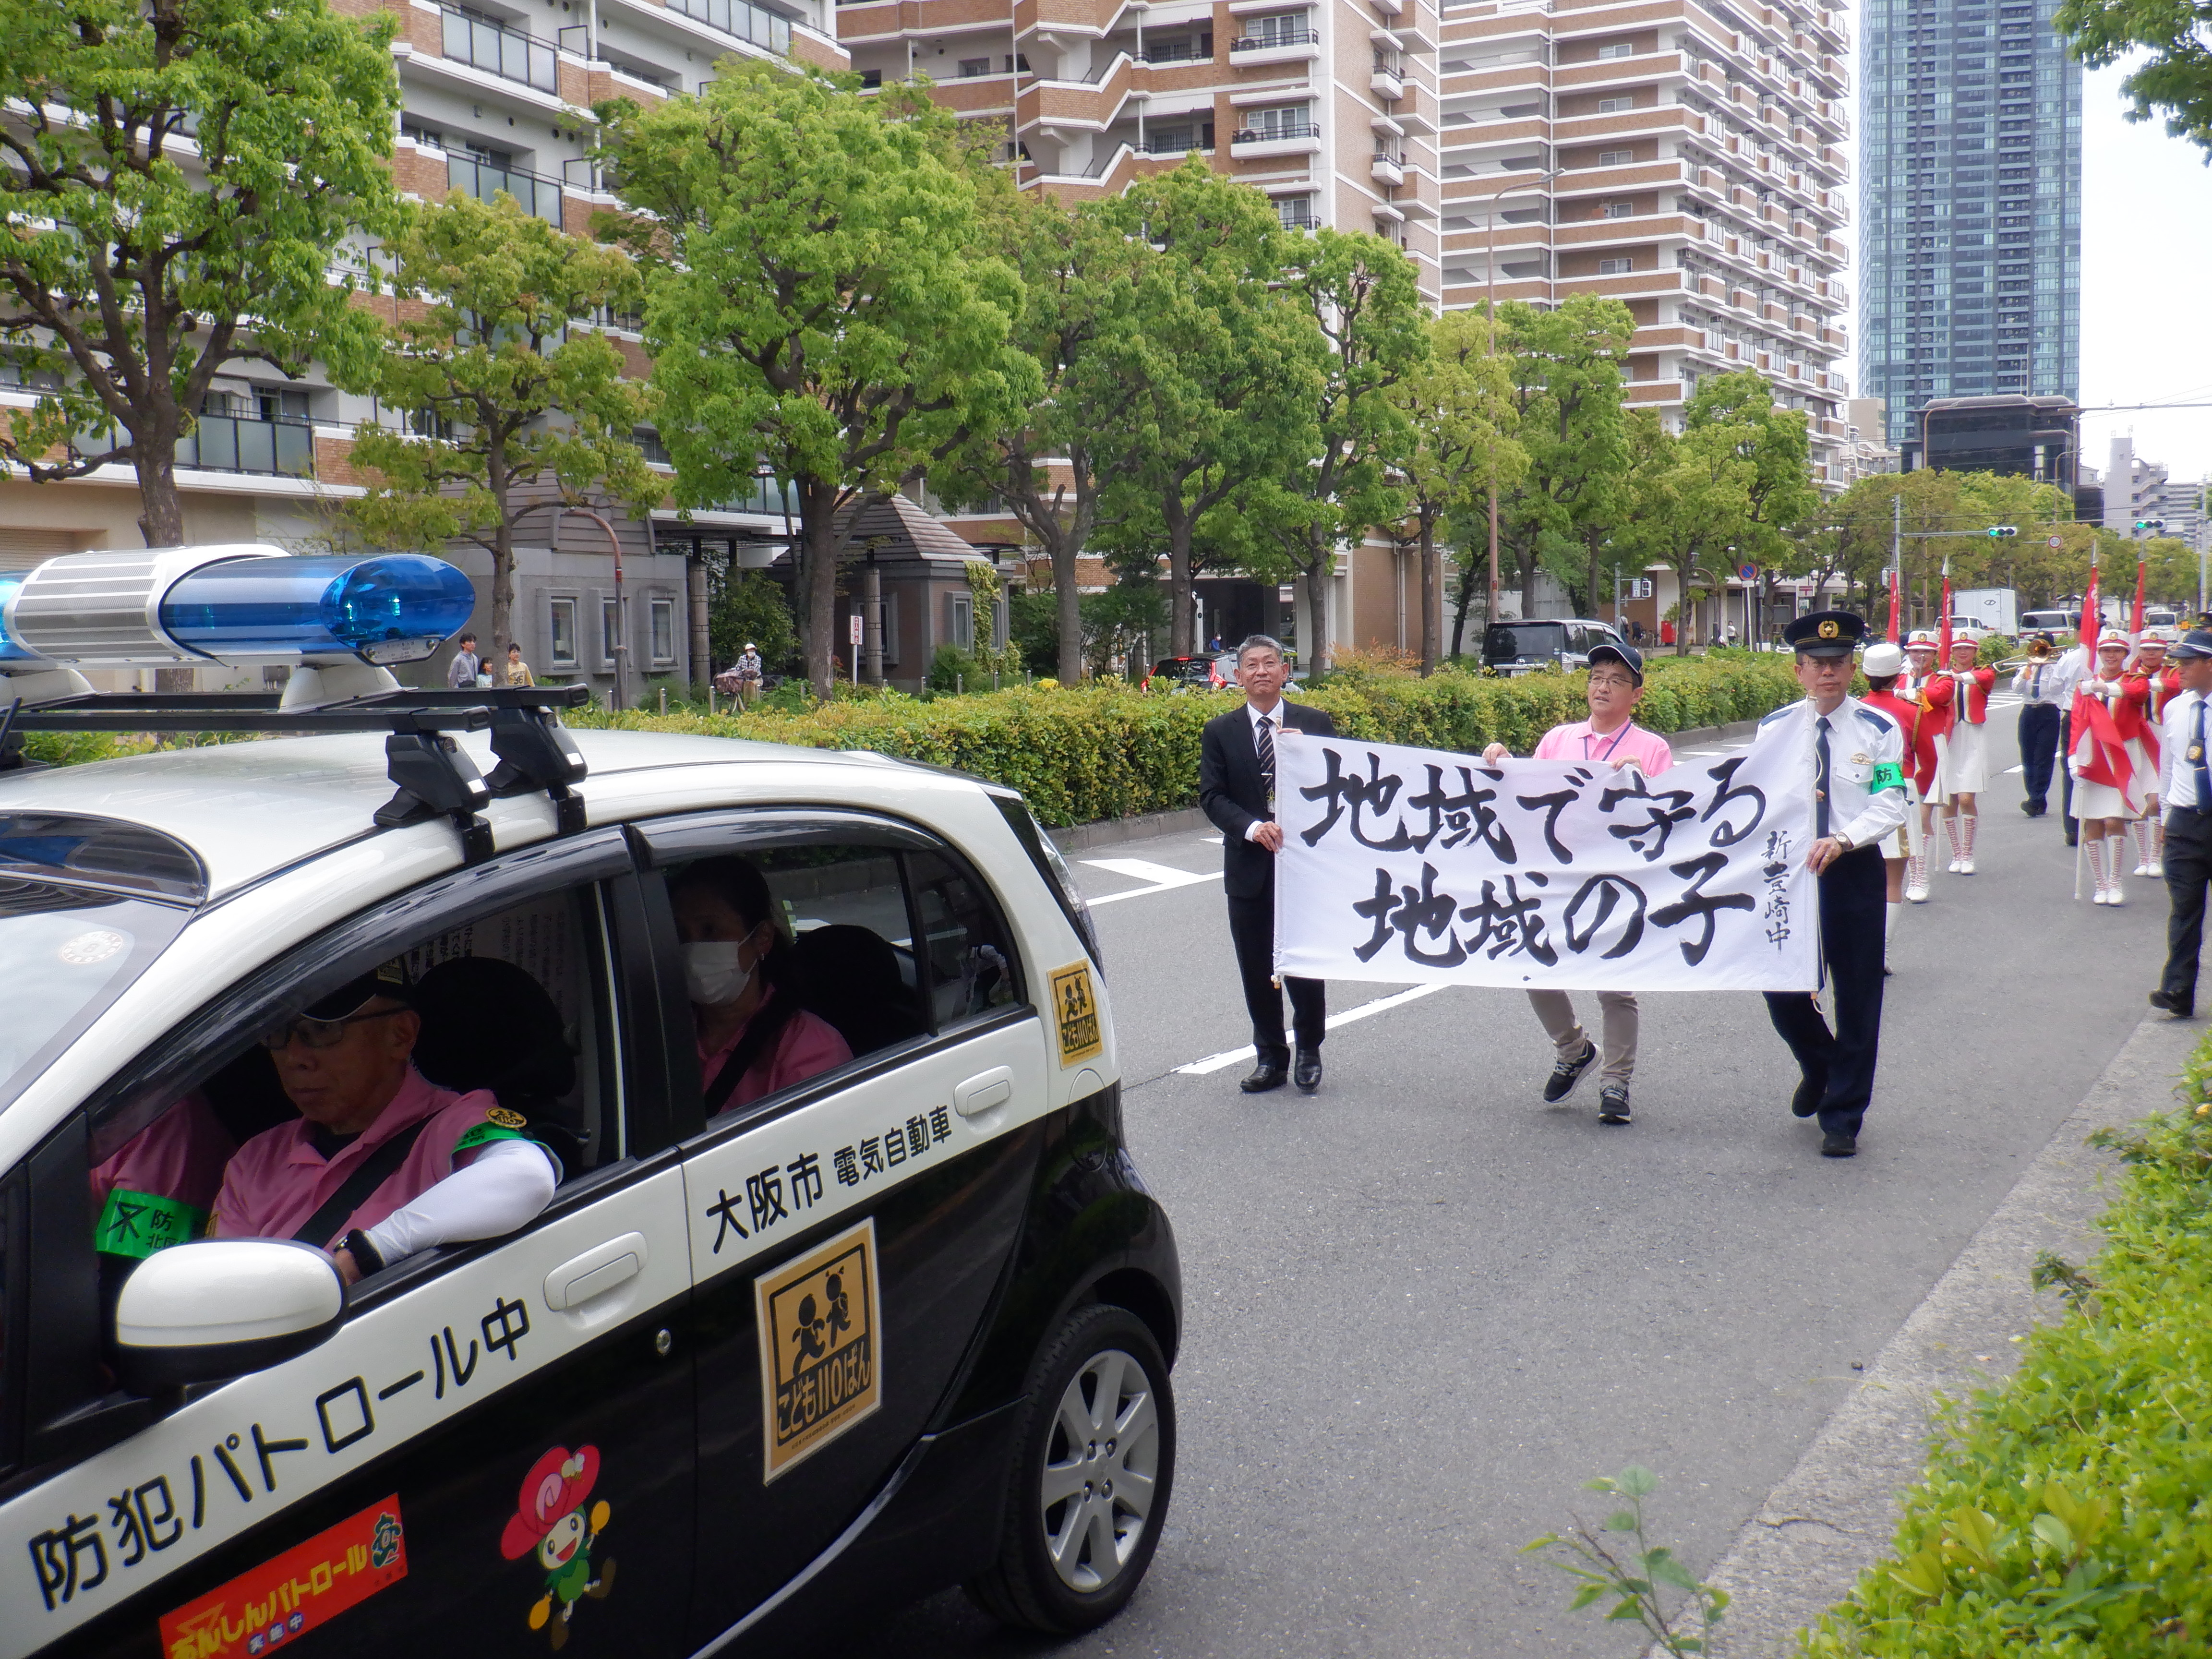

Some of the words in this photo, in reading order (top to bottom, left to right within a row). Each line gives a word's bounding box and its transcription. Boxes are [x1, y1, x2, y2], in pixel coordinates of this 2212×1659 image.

[1299, 747, 1766, 865] 地域で守る
[1352, 852, 1756, 968] 地域の子
[1761, 830, 1792, 955] 新豊崎中
[707, 1153, 823, 1254] 大阪市
[834, 1105, 952, 1187] 電気自動車
[778, 1341, 870, 1439] こども110ばん
[29, 1297, 531, 1611] 防犯パトロール中
[170, 1544, 368, 1659] あんしんパトロール
